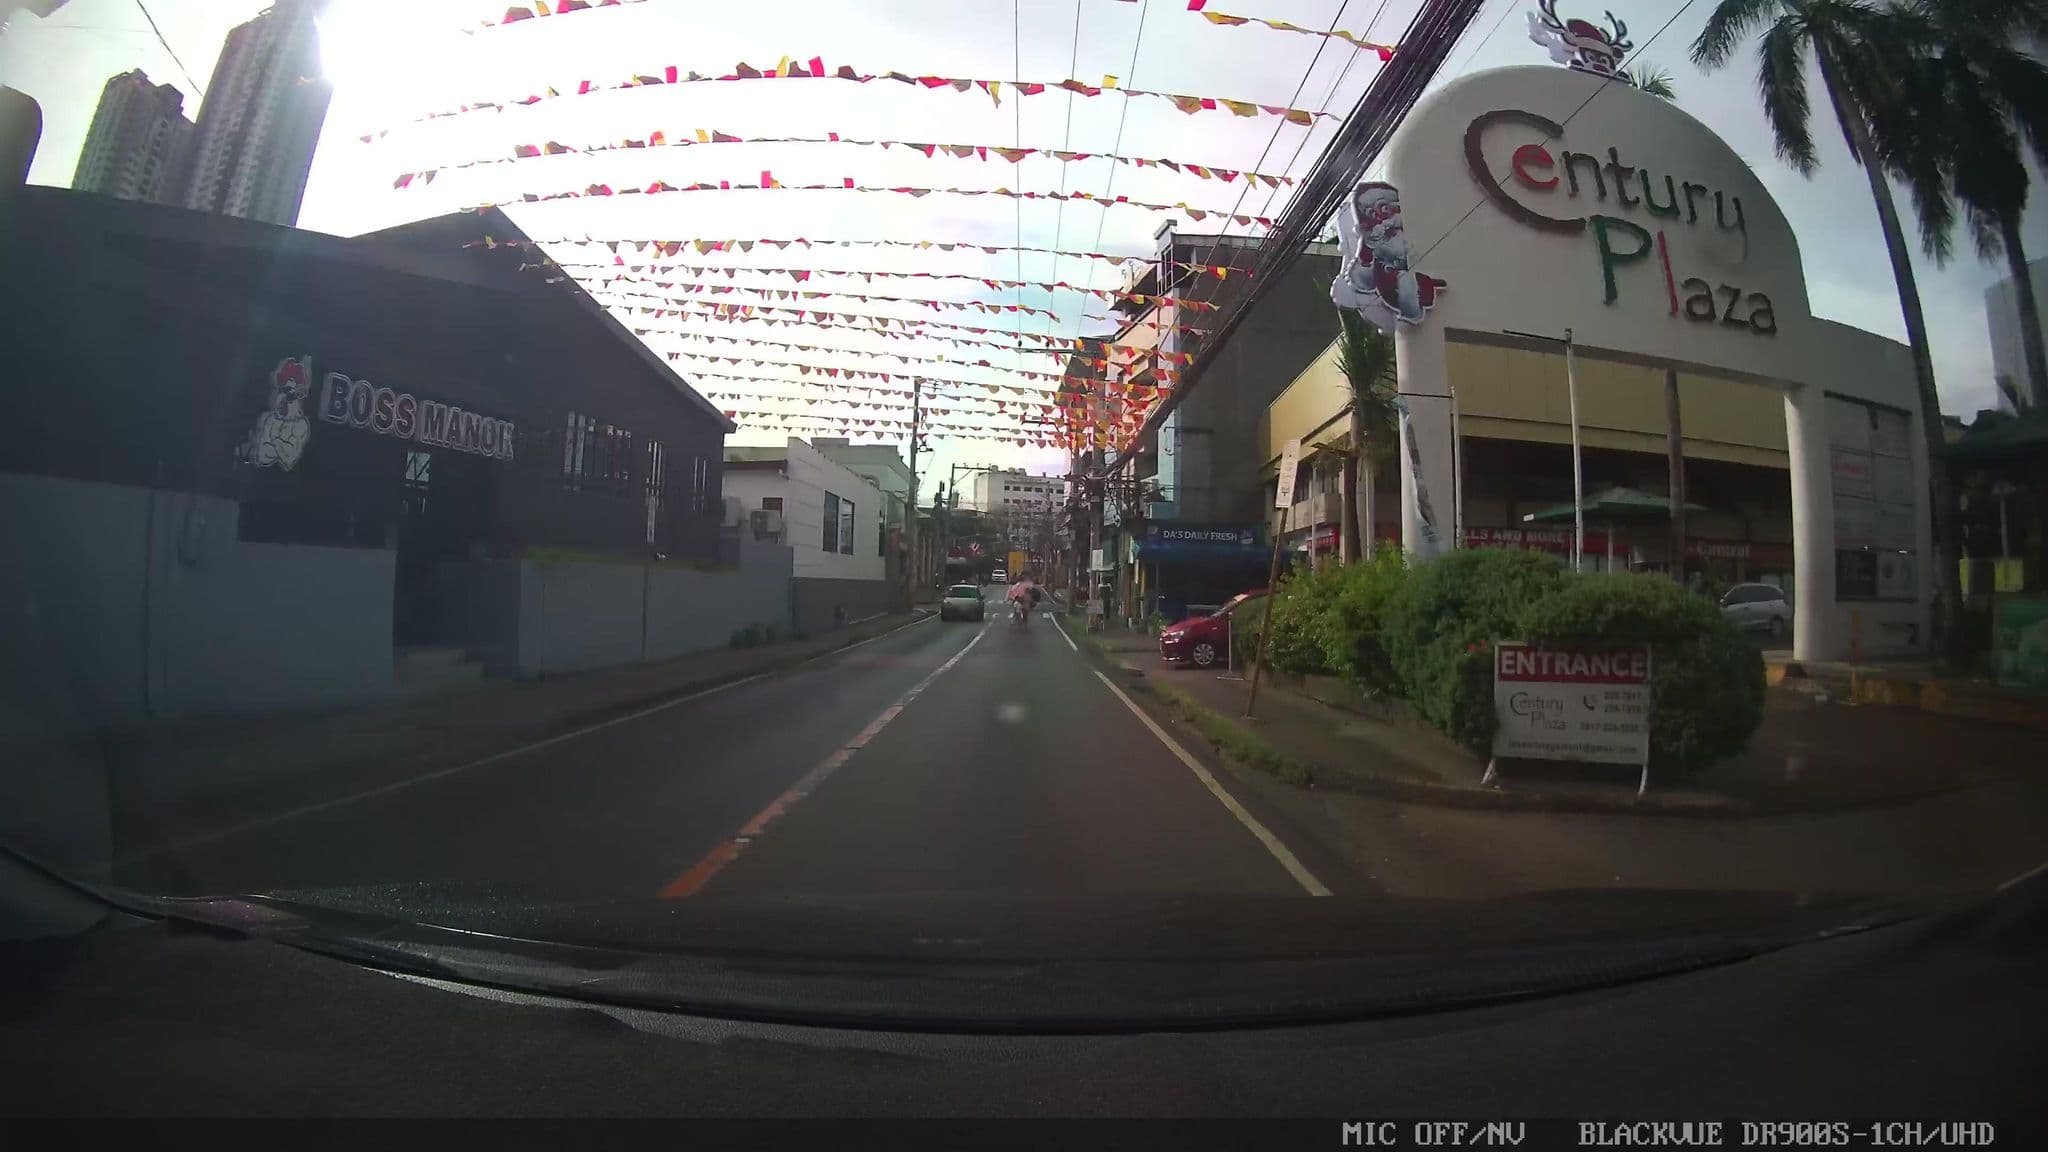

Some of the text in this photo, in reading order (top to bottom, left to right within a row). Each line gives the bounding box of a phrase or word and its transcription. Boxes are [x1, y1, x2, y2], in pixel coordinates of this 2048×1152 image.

[1464, 109, 1748, 263] Century
[1589, 214, 1777, 333] Plaza
[320, 372, 514, 461] BOSS MANOK
[1184, 531, 1209, 541] DAILY
[1211, 532, 1237, 541] FRESH
[1492, 529, 1522, 542] AND
[1501, 650, 1646, 677] ENTRANCE
[1510, 692, 1563, 715] Century
